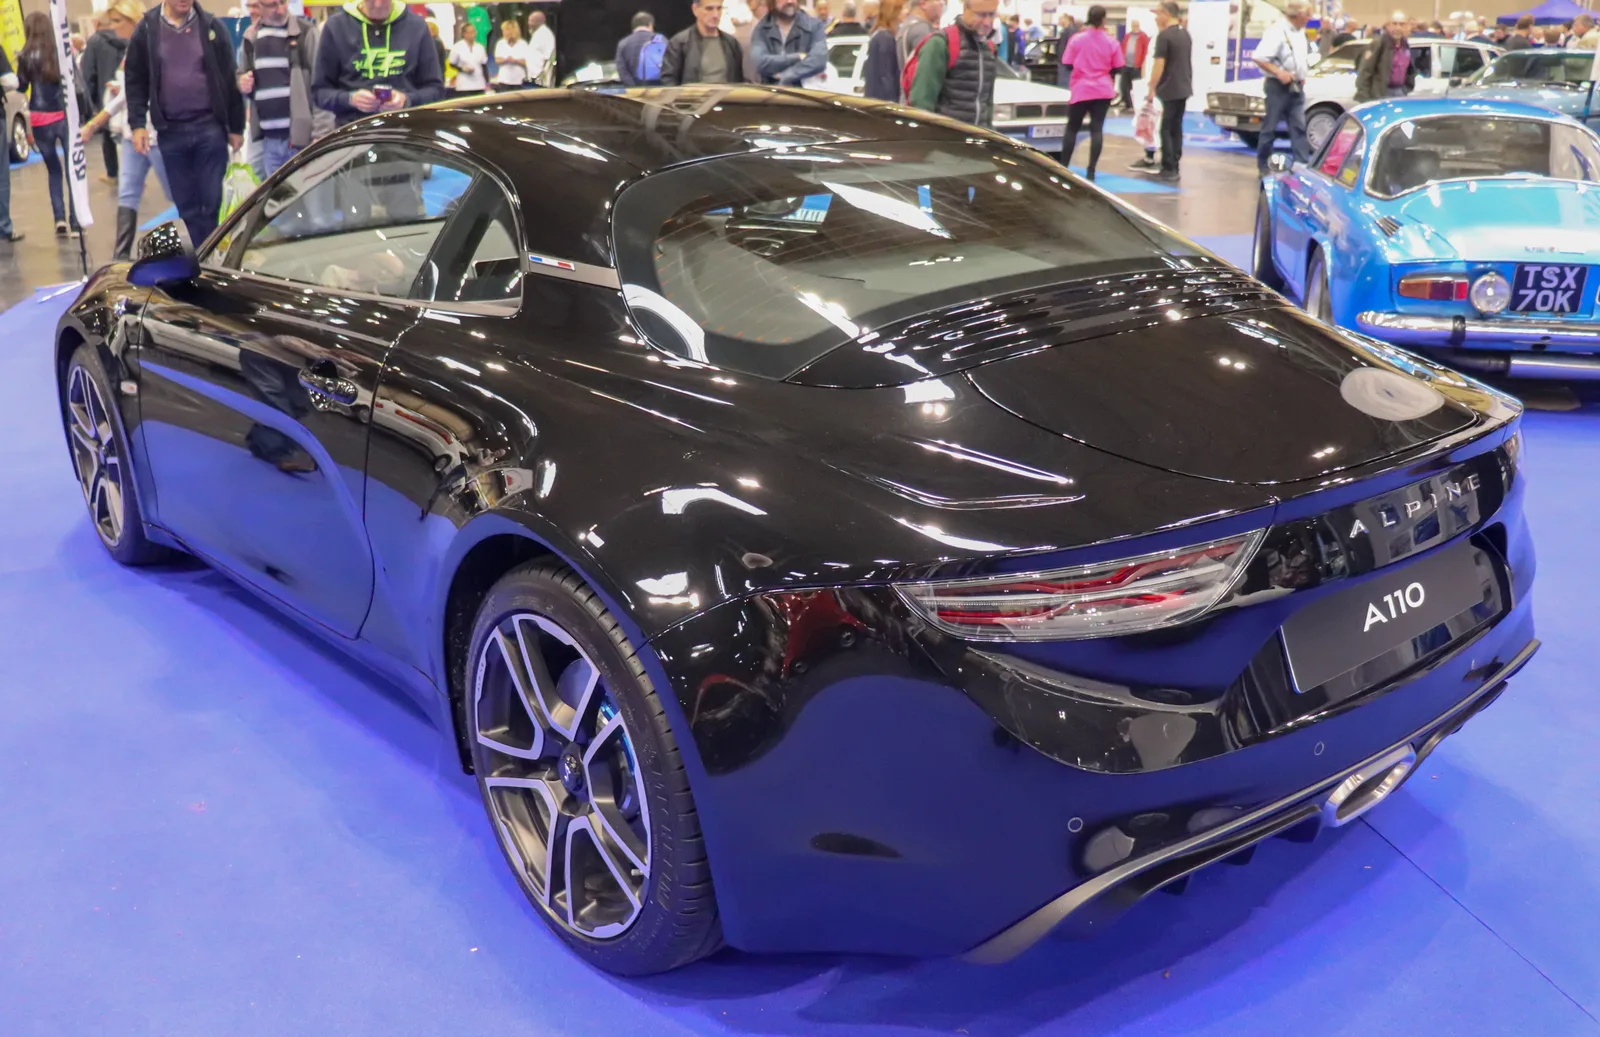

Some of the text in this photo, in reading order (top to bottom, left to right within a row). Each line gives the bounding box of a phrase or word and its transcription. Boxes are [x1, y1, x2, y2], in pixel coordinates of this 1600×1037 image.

[1524, 266, 1580, 289] TSX
[1516, 289, 1575, 312] 70K
[1349, 473, 1481, 539] ALPINE
[1363, 582, 1425, 632] A110
